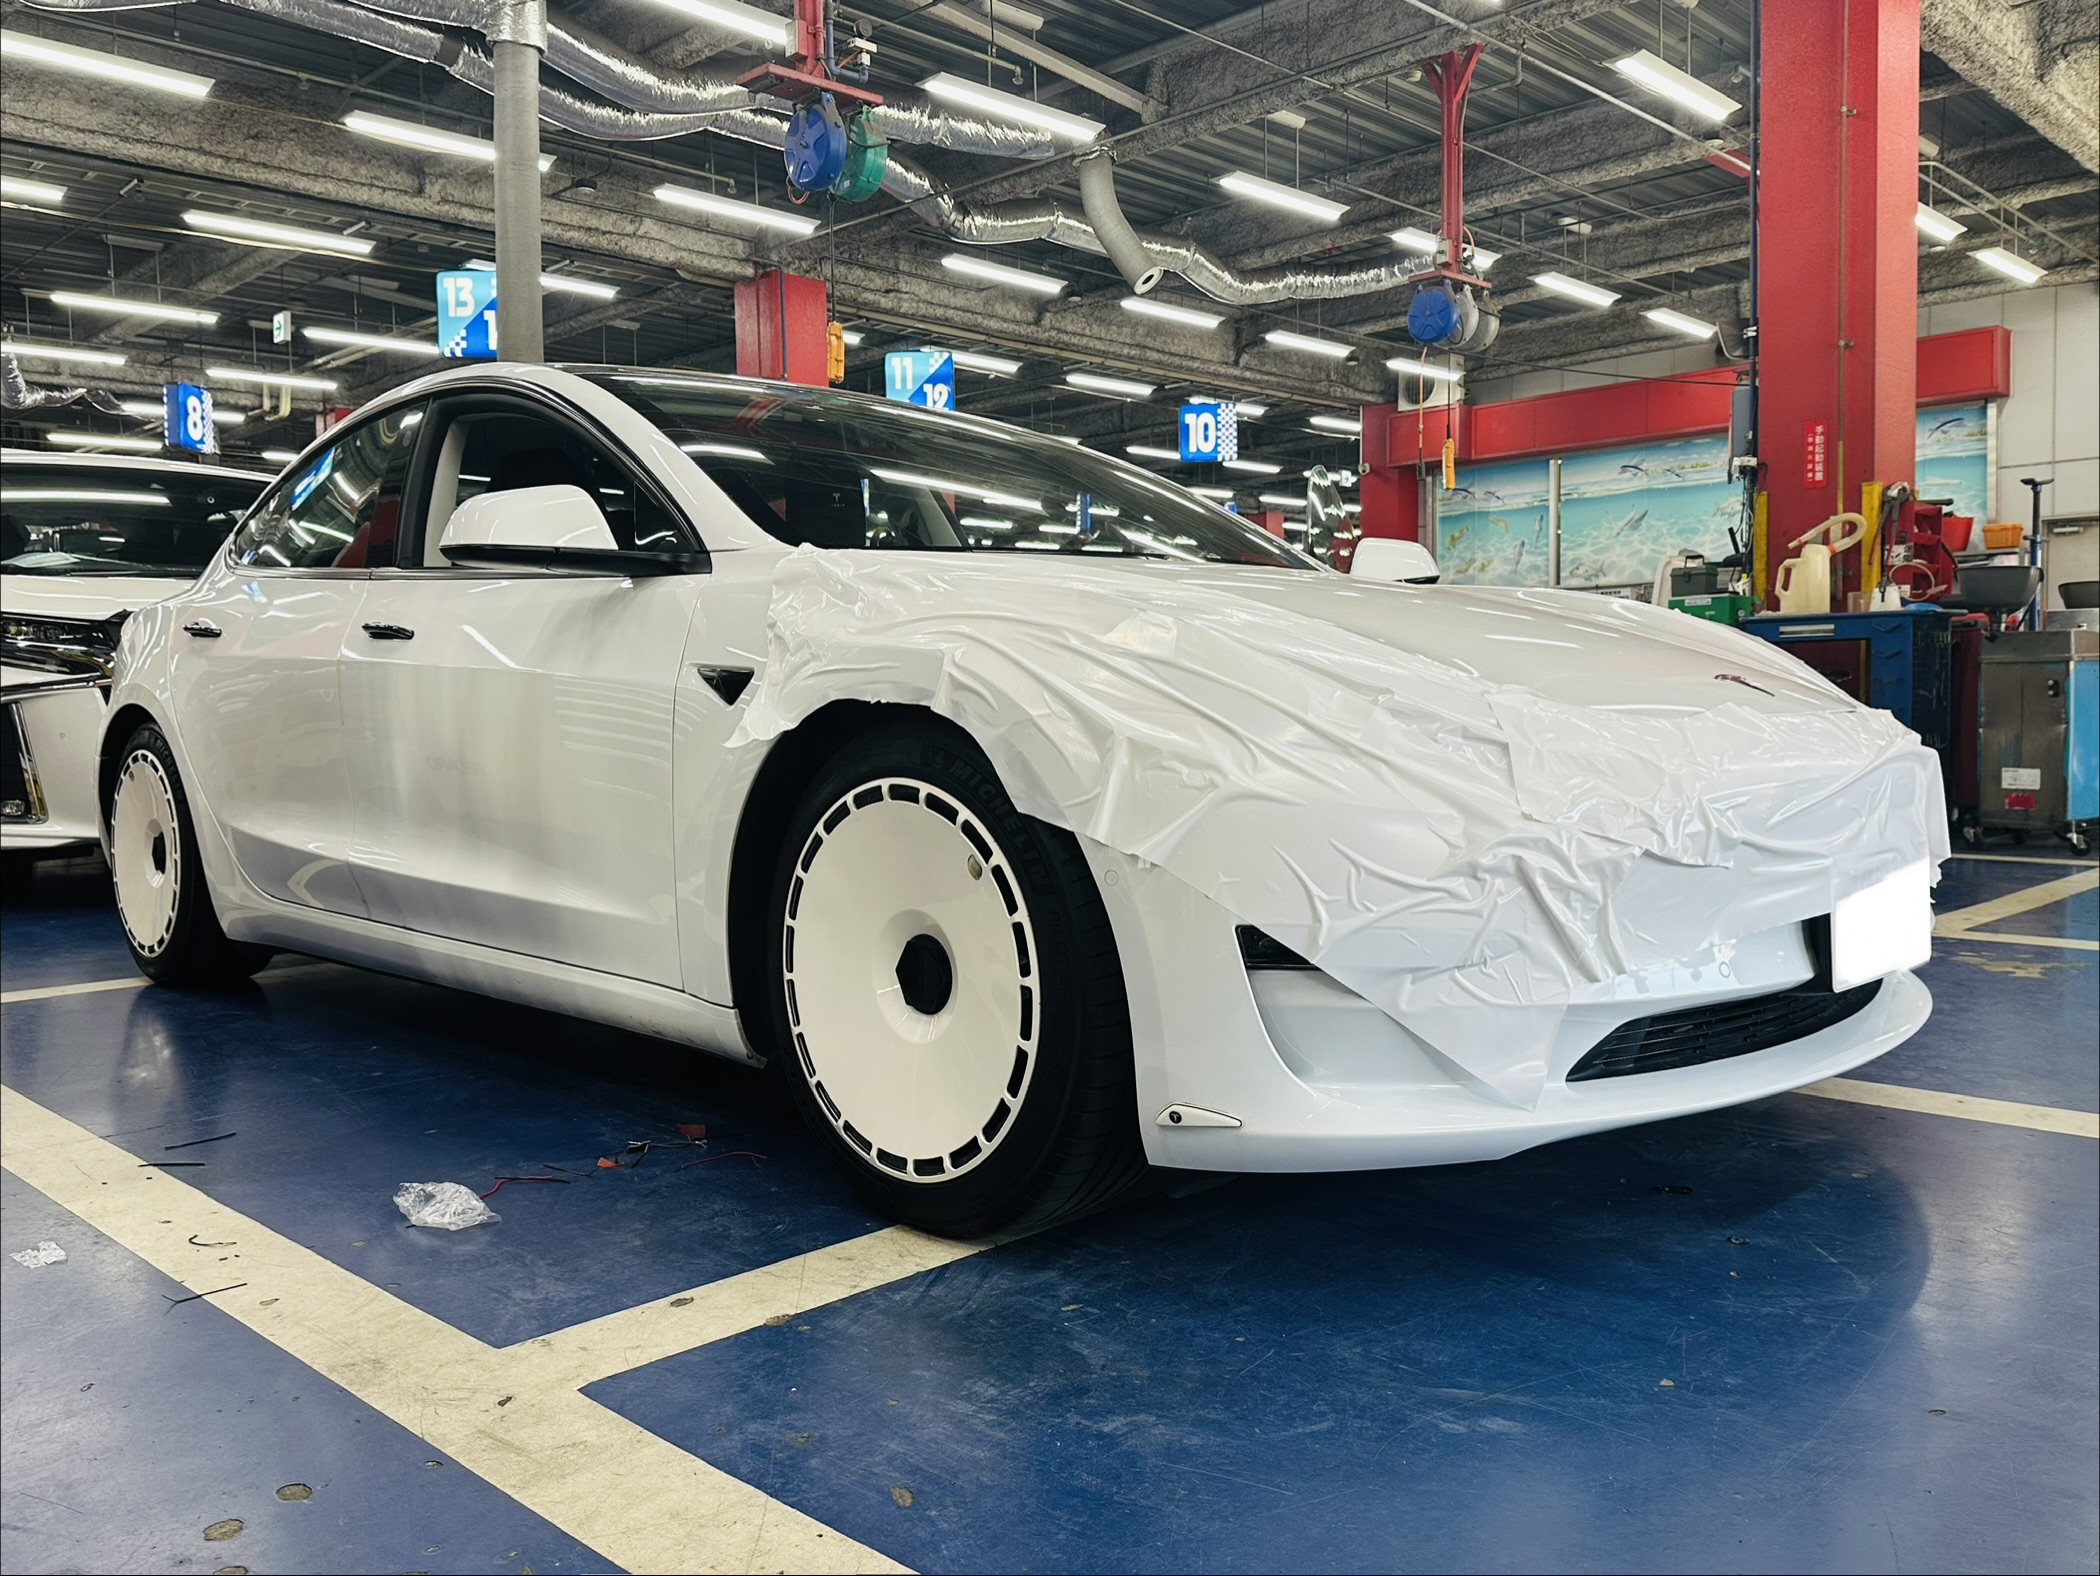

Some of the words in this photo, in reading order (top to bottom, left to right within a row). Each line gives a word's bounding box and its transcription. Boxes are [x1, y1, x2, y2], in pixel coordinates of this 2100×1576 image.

[443, 277, 475, 318] 13
[891, 356, 914, 390] 11
[922, 382, 950, 410] 12
[186, 394, 204, 442] 8
[1184, 411, 1217, 454] 10
[948, 758, 1051, 887] MICHELIN
